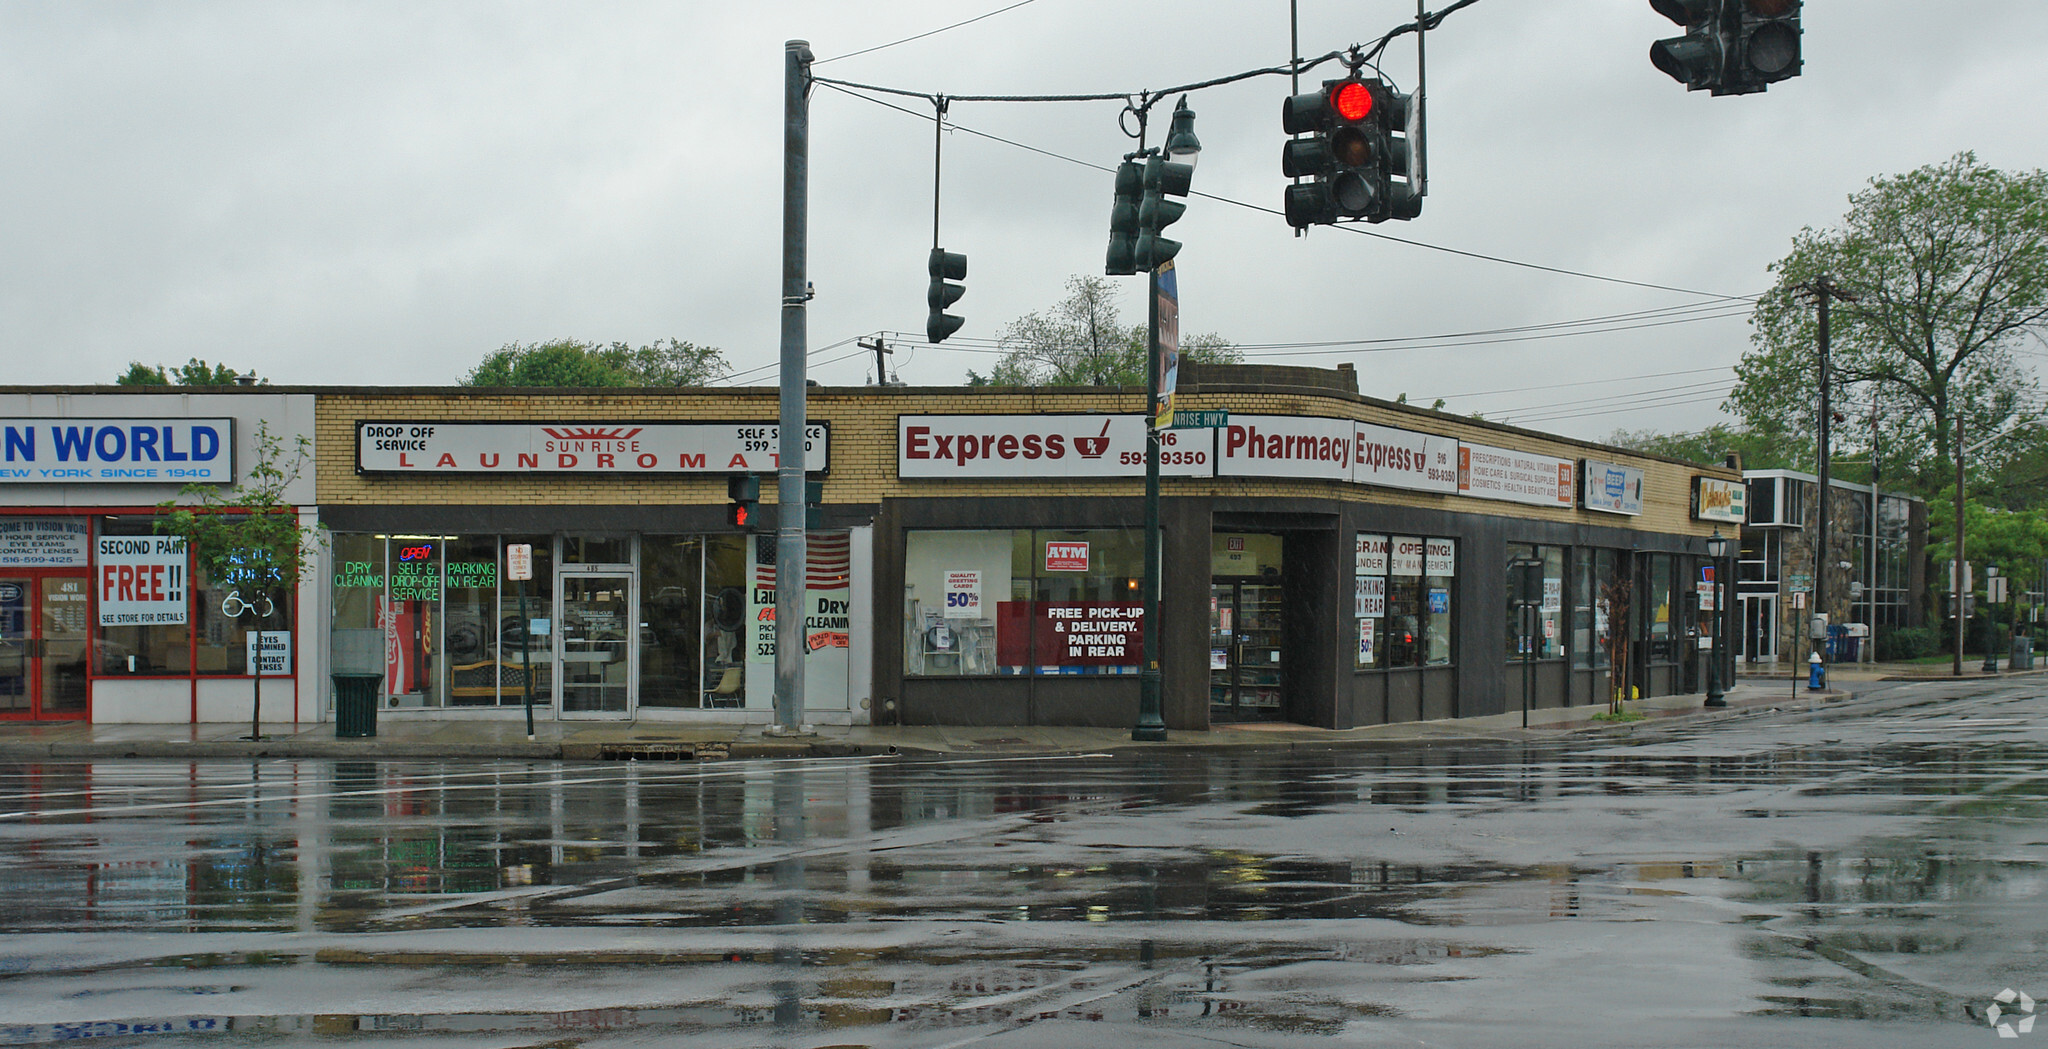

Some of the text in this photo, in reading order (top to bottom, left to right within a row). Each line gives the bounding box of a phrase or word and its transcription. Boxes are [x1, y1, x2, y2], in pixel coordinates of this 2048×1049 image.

[1174, 411, 1227, 426] NRISE HWY.
[367, 426, 435, 437] DROP OFF
[738, 428, 765, 439] SELF
[51, 425, 220, 462] WORLD
[375, 440, 426, 450] SERVICE
[1160, 433, 1177, 446] 16
[545, 441, 640, 452] SUNRISE
[906, 426, 1066, 467] Express
[1226, 424, 1350, 469] Pharmacy
[1356, 432, 1411, 473] Express
[1120, 452, 1206, 465] 599350
[1437, 452, 1447, 465] 516
[1472, 452, 1511, 467] PRESCRIPTIONS
[39, 469, 93, 477] YORK
[101, 469, 158, 477] SINCE
[166, 469, 211, 477] 1940
[1428, 468, 1455, 483] 593-9350
[1474, 466, 1488, 477] HOME
[1490, 468, 1504, 479] CARE
[1472, 478, 1501, 491] COSMETICS
[1504, 483, 1522, 494] HEALTH
[24, 521, 34, 531] TO
[36, 521, 63, 532] VISION
[66, 523, 87, 534] WORL
[100, 540, 150, 555] SECOND
[401, 546, 431, 559] OPEN
[1048, 546, 1087, 559] ATM
[345, 562, 372, 575] DRY
[398, 562, 435, 575] SELF &
[447, 562, 495, 575] PARKING
[1392, 559, 1403, 569] EW
[1406, 560, 1452, 571] MANGEMENT
[60, 582, 78, 592] 481
[335, 575, 384, 588] CLEANING
[391, 575, 440, 588] DROP-OFF
[447, 576, 495, 588] IN REAR
[1356, 579, 1384, 596] PARKING
[48, 594, 87, 602] VISION WORL
[392, 588, 439, 601] SERVICE
[754, 587, 776, 605] Lau
[1048, 607, 1145, 618] FREE PICK-UP
[1364, 598, 1383, 614] REAR
[102, 612, 184, 623] SEE STORE FOR DETAILS
[806, 616, 849, 628] CLEANIN
[1055, 621, 1138, 632] & DELIVERY.
[760, 633, 775, 641] DEL
[1068, 634, 1126, 645] PARKING
[757, 643, 776, 656] 523
[1069, 646, 1125, 657] IN REAR
